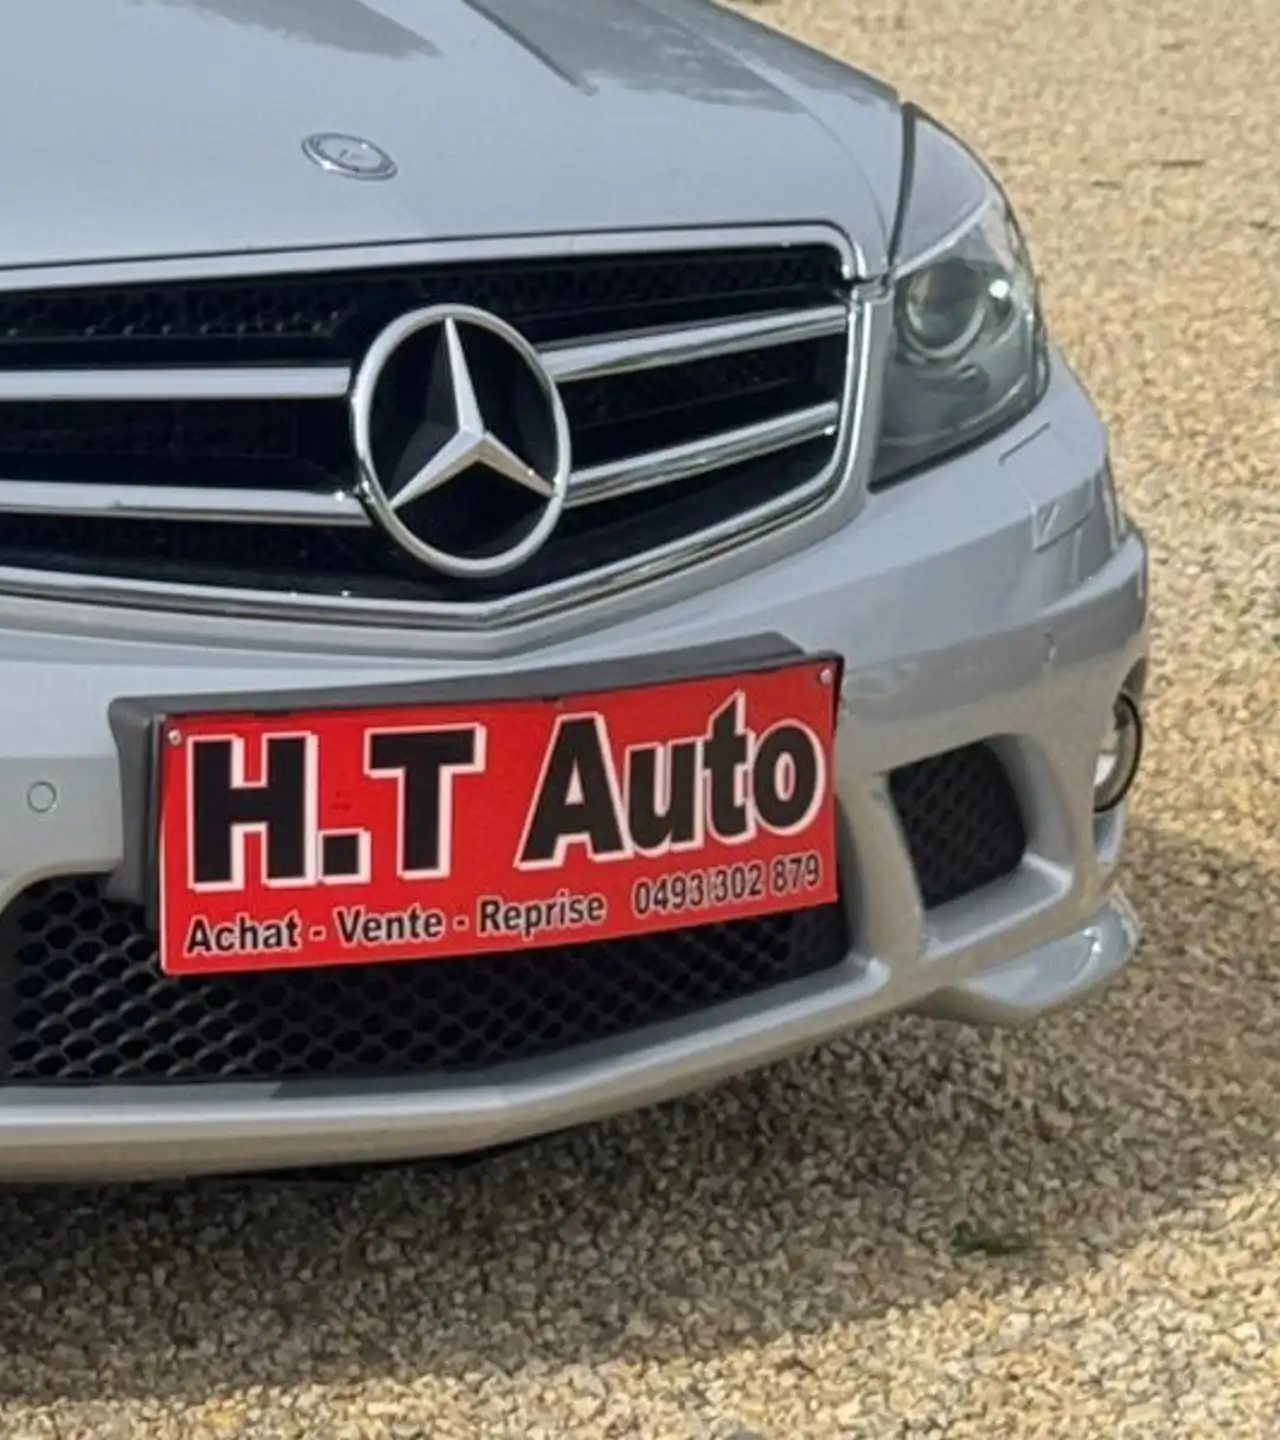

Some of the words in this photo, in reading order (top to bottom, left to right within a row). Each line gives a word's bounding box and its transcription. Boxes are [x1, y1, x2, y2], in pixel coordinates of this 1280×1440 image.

[187, 723, 486, 891] H.T
[515, 691, 826, 869] Auto
[184, 909, 301, 958] Achat
[334, 902, 443, 948] Vente
[477, 889, 607, 942] Reprise
[770, 850, 821, 896] 879
